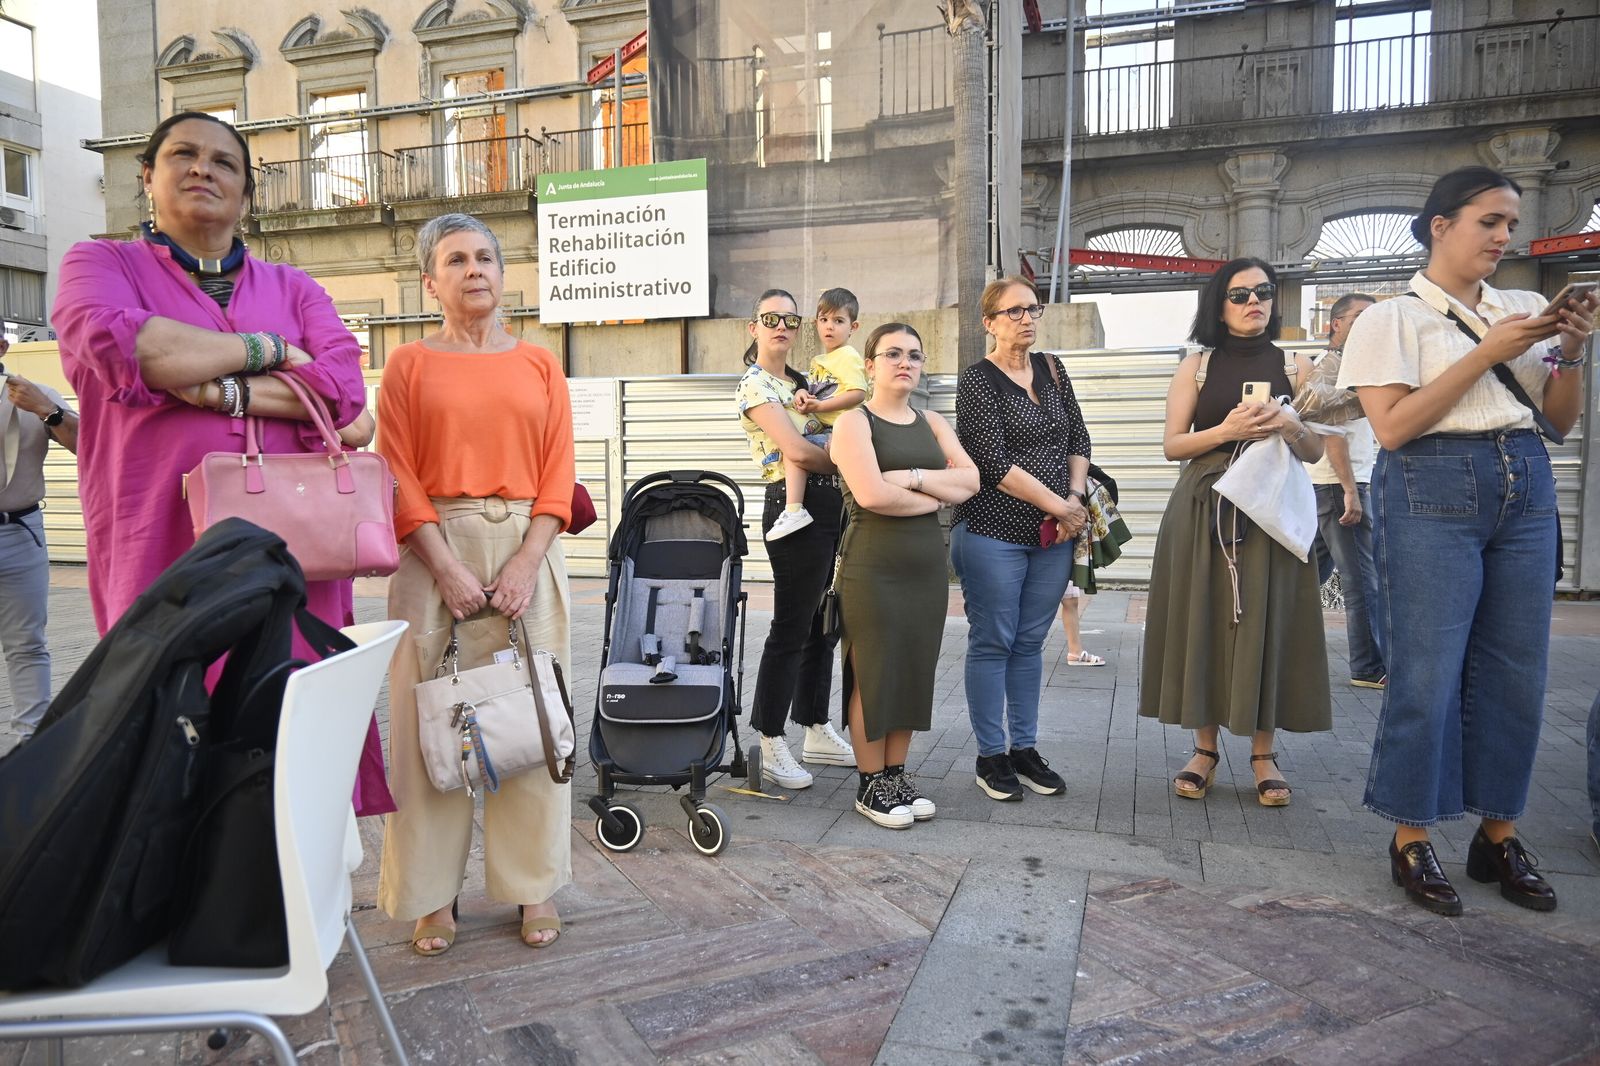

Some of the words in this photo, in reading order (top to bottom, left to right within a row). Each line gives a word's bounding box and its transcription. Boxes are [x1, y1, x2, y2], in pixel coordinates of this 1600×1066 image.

[548, 204, 666, 230] Terminación
[549, 228, 685, 254] Rehabilitación
[550, 257, 616, 277] Edificio
[549, 278, 692, 302] Administrativo
